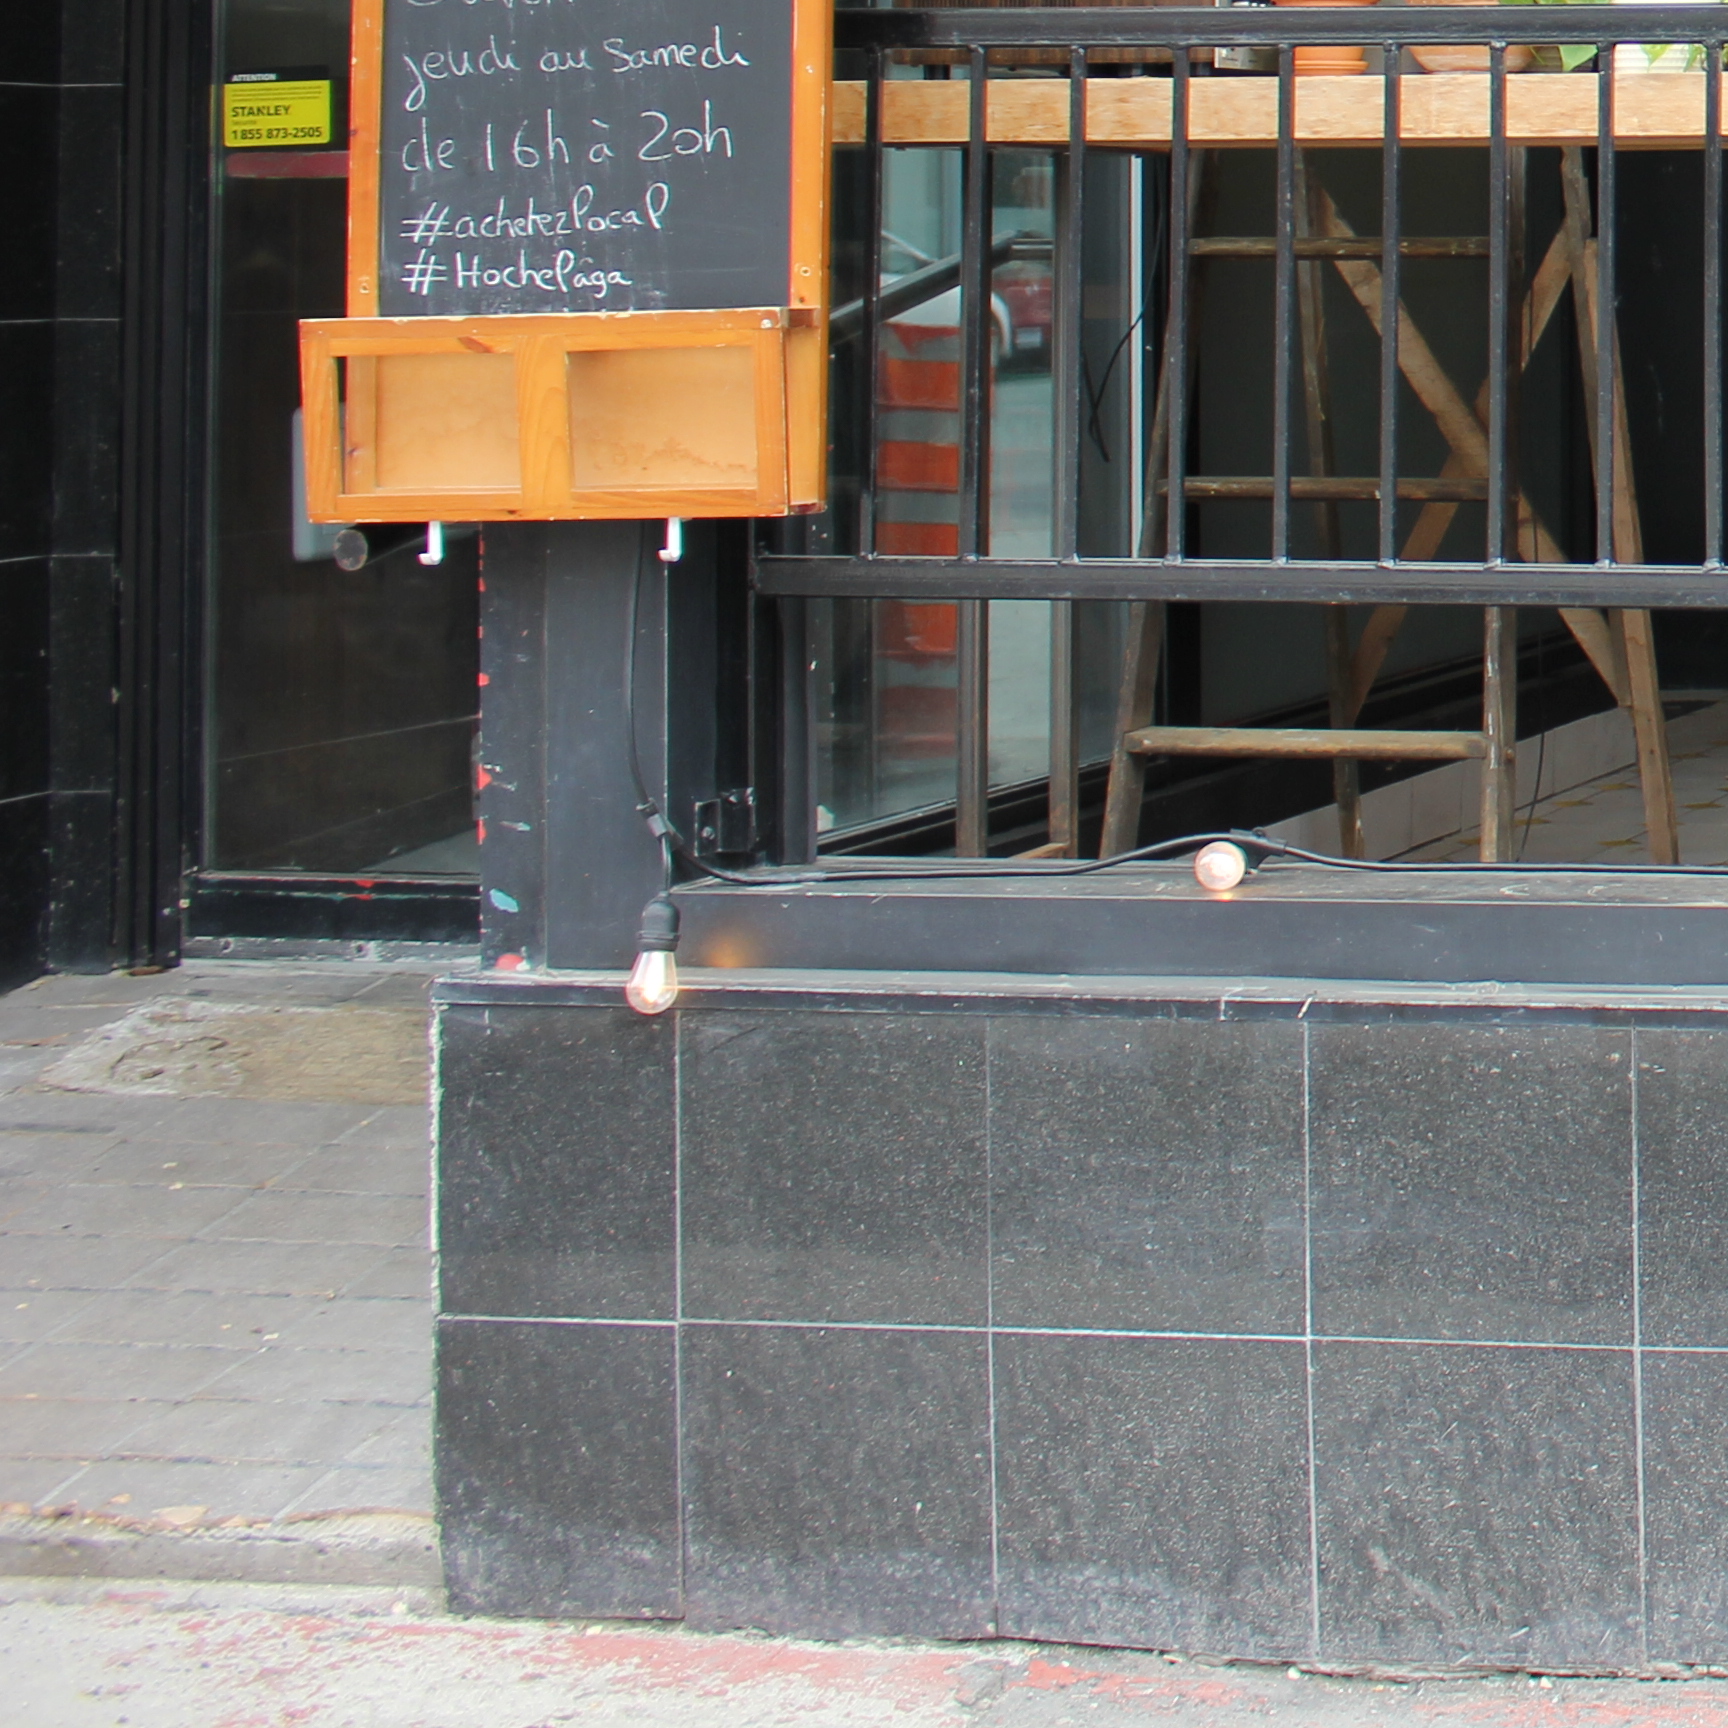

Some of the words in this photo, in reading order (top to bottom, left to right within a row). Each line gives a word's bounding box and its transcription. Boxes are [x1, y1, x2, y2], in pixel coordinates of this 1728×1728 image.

[231, 73, 277, 82] ATTENTION
[403, 34, 520, 112] jeudi
[540, 47, 594, 73] au
[231, 104, 291, 118] STANLEY
[266, 126, 322, 140] 873-2505
[402, 116, 457, 172] de
[485, 108, 569, 172] 16h
[589, 118, 615, 163] à
[638, 99, 734, 162] 20h
[399, 182, 671, 247] #achetezlocal
